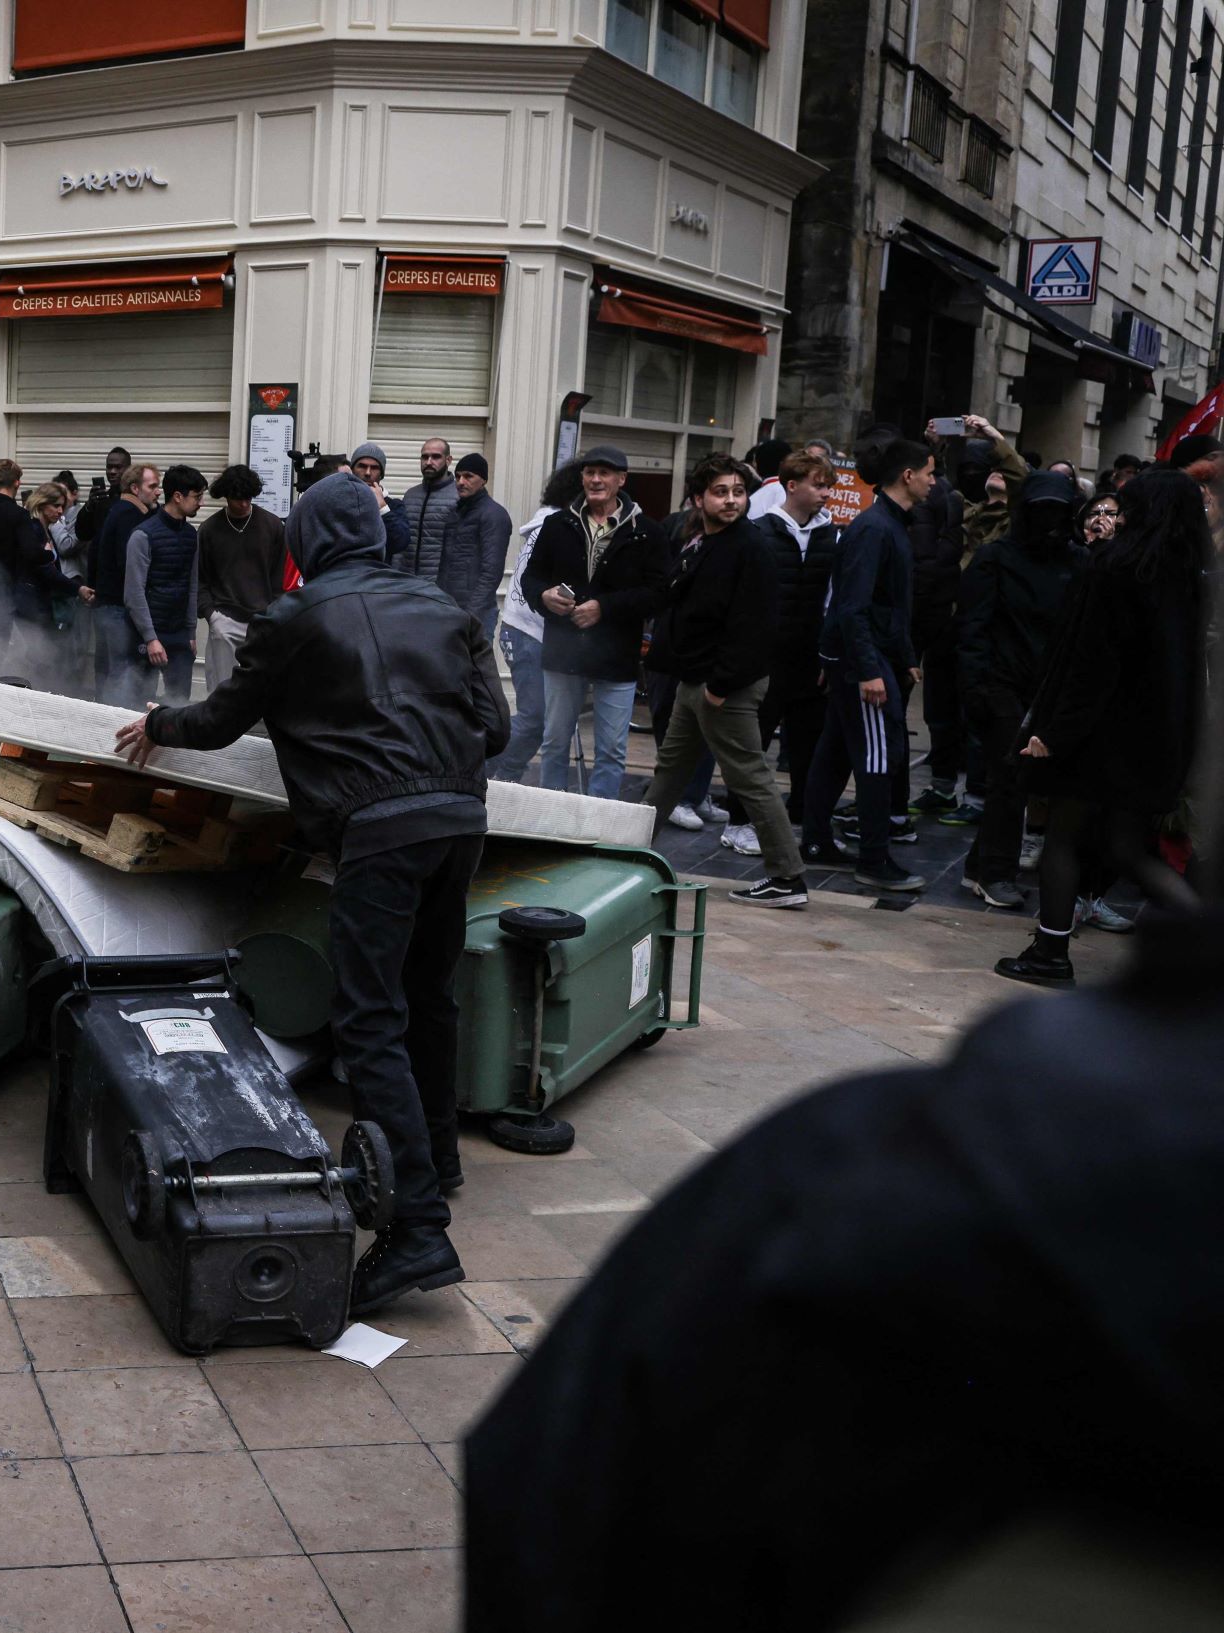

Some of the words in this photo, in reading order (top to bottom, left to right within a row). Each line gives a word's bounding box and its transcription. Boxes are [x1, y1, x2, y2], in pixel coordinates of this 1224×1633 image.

[388, 270, 430, 284] CREPES
[432, 271, 443, 285] ET
[446, 272, 496, 287] GALETTES
[1036, 285, 1083, 297] ALDI
[12, 297, 54, 311] CREPES
[56, 296, 68, 309] ET
[71, 293, 124, 308] GALETTES
[126, 289, 201, 305] ARTISANALES
[837, 472, 855, 486] NEZ
